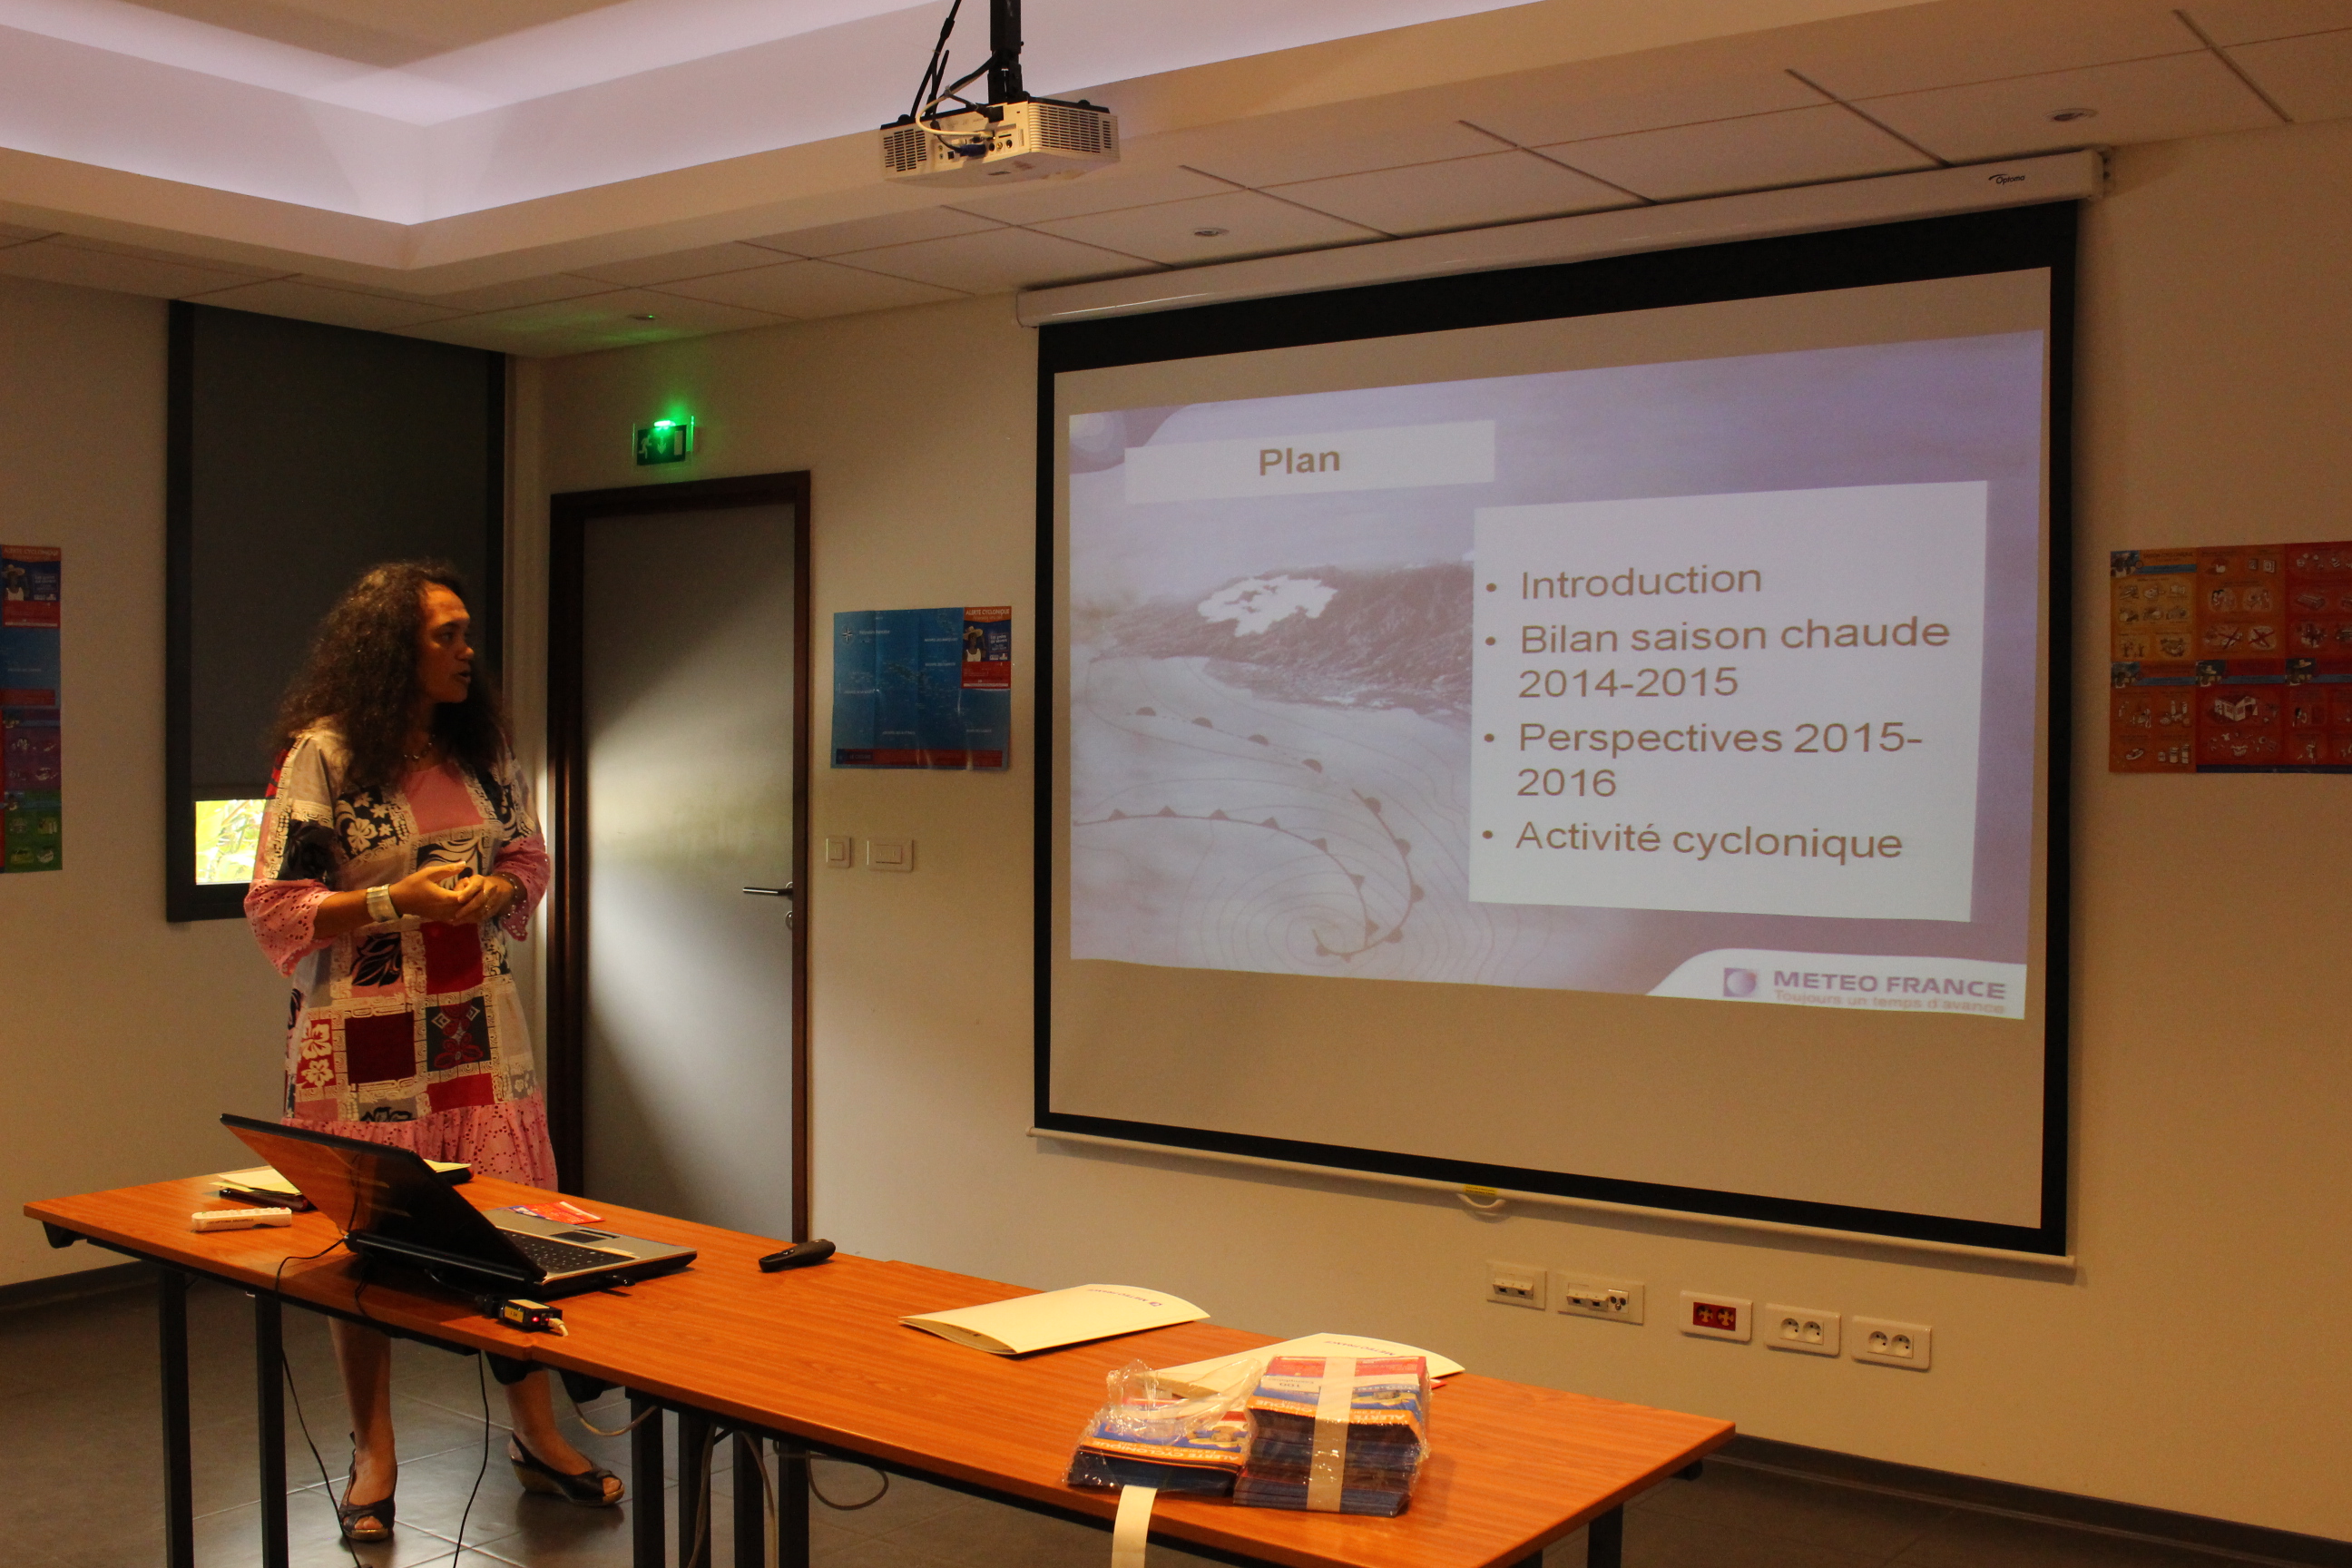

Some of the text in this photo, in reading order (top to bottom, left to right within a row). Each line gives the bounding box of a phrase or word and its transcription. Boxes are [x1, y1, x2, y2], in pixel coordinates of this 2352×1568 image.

[1993, 174, 2025, 185] Optoma
[1259, 447, 1340, 475] Plan
[1521, 564, 1762, 600] Introduction
[1521, 616, 1950, 654] Bilan saison chaude
[1519, 667, 1739, 699] 2014-2015
[1519, 722, 1922, 759] Perspectives 2015-
[1517, 769, 1617, 798] 2016
[1515, 822, 1903, 866] Activité cyclonique
[1774, 970, 2006, 1000] METEO FRANCE
[1775, 989, 1841, 1004] Toujours
[1847, 995, 1867, 1006] un
[1873, 997, 1922, 1010] temps
[1091, 1440, 1240, 1462] ALERTE CYCLONIQUE
